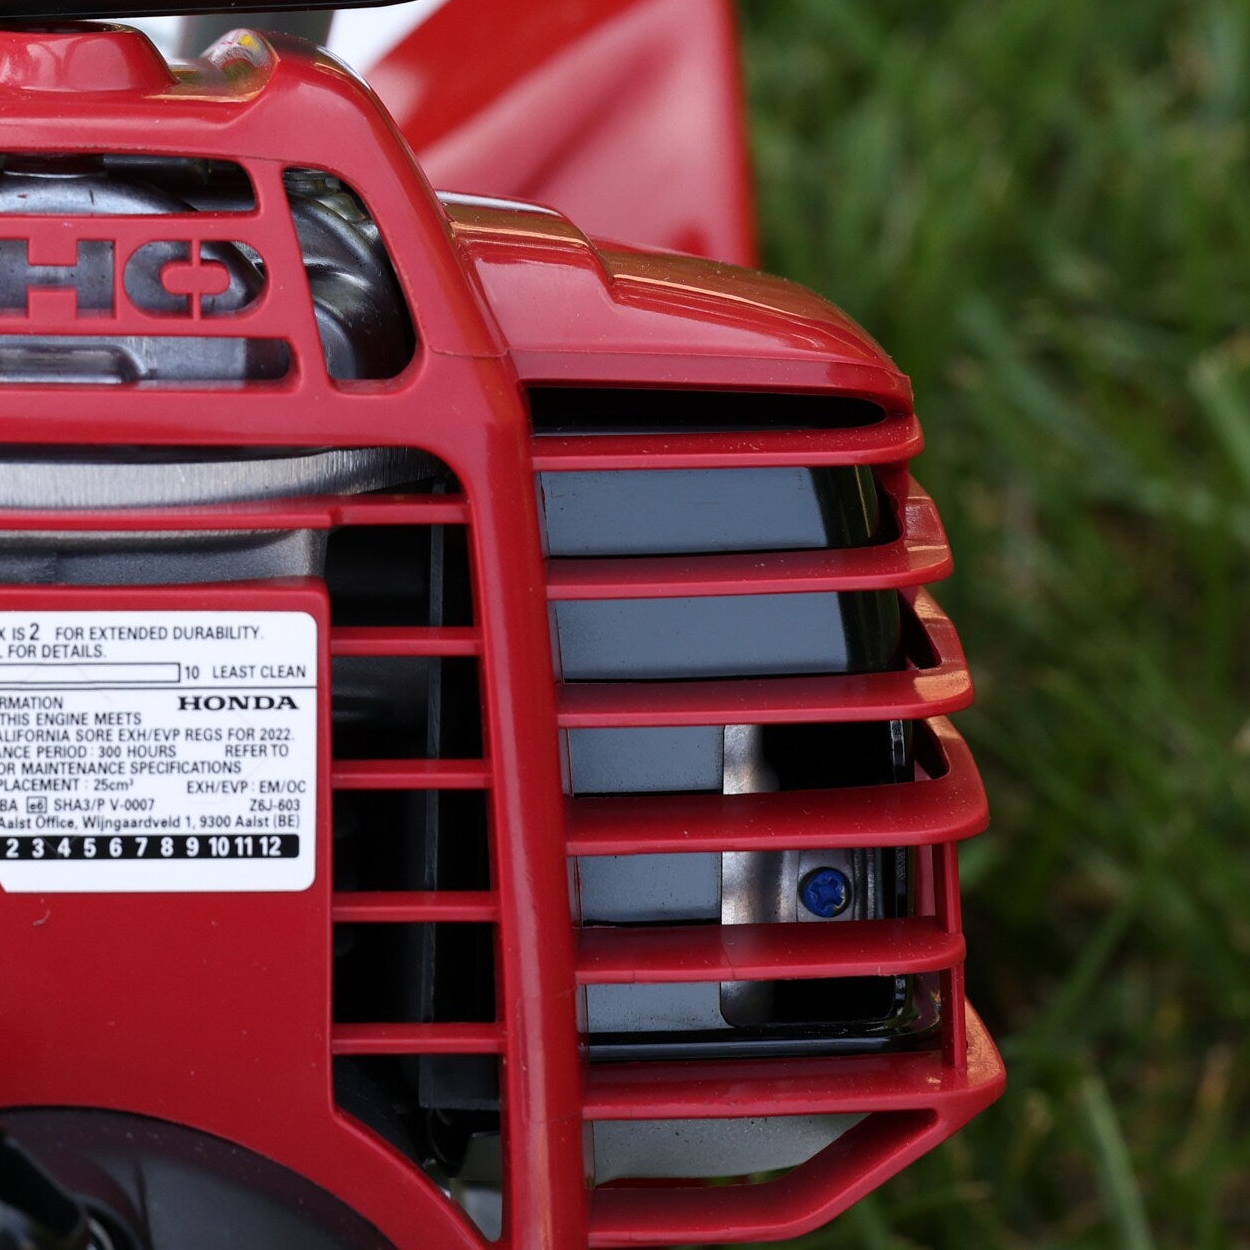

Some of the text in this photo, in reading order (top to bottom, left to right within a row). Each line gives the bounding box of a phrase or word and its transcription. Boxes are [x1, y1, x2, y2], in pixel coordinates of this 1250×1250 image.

[12, 627, 25, 641] IS
[29, 623, 40, 640] 2
[56, 627, 84, 640] FOR
[90, 626, 168, 640] EXTENDED
[173, 626, 264, 640] DURABILITY.
[8, 645, 36, 658] FOR
[42, 644, 106, 658] DETAILS.
[184, 666, 200, 680] 10
[212, 665, 255, 679] LEAST
[260, 665, 306, 679] CLEAN
[177, 696, 300, 711] HONDA
[0, 713, 30, 725] THIS
[36, 712, 88, 726] ENGINE
[94, 712, 141, 725] MEETS
[76, 728, 113, 742] SORE
[118, 728, 180, 742] EXH/EVP
[185, 728, 222, 741] REGS
[228, 728, 255, 741] FOR
[260, 728, 295, 741] 2022.
[36, 745, 87, 759] PERIOD
[99, 745, 121, 759] 300
[127, 745, 176, 758] HOURS
[225, 744, 268, 758] REFER
[271, 744, 289, 757] TO
[21, 762, 125, 775] MAINTENANCE
[130, 761, 241, 775] SPECIFICATIONS
[187, 780, 248, 794] EXH/EVP
[259, 780, 306, 793] EM/OC
[54, 798, 105, 811] SHA3/P
[110, 798, 155, 811] V-0007
[249, 798, 300, 811] Z6J-603
[35, 815, 77, 831] Office,
[82, 814, 180, 831] Wijngaardveld
[200, 815, 230, 828] 9300
[236, 815, 269, 828] Aalst
[273, 814, 301, 830] (BE)
[5, 837, 19, 859] 2
[32, 838, 45, 859] 3
[57, 837, 71, 858] 4
[83, 837, 96, 858] 5
[109, 837, 122, 858] 6
[135, 837, 148, 858] 7
[160, 837, 174, 858] 8
[186, 837, 199, 858] 9
[209, 836, 230, 858] 10
[234, 836, 253, 857] 11
[259, 836, 282, 857] 12
